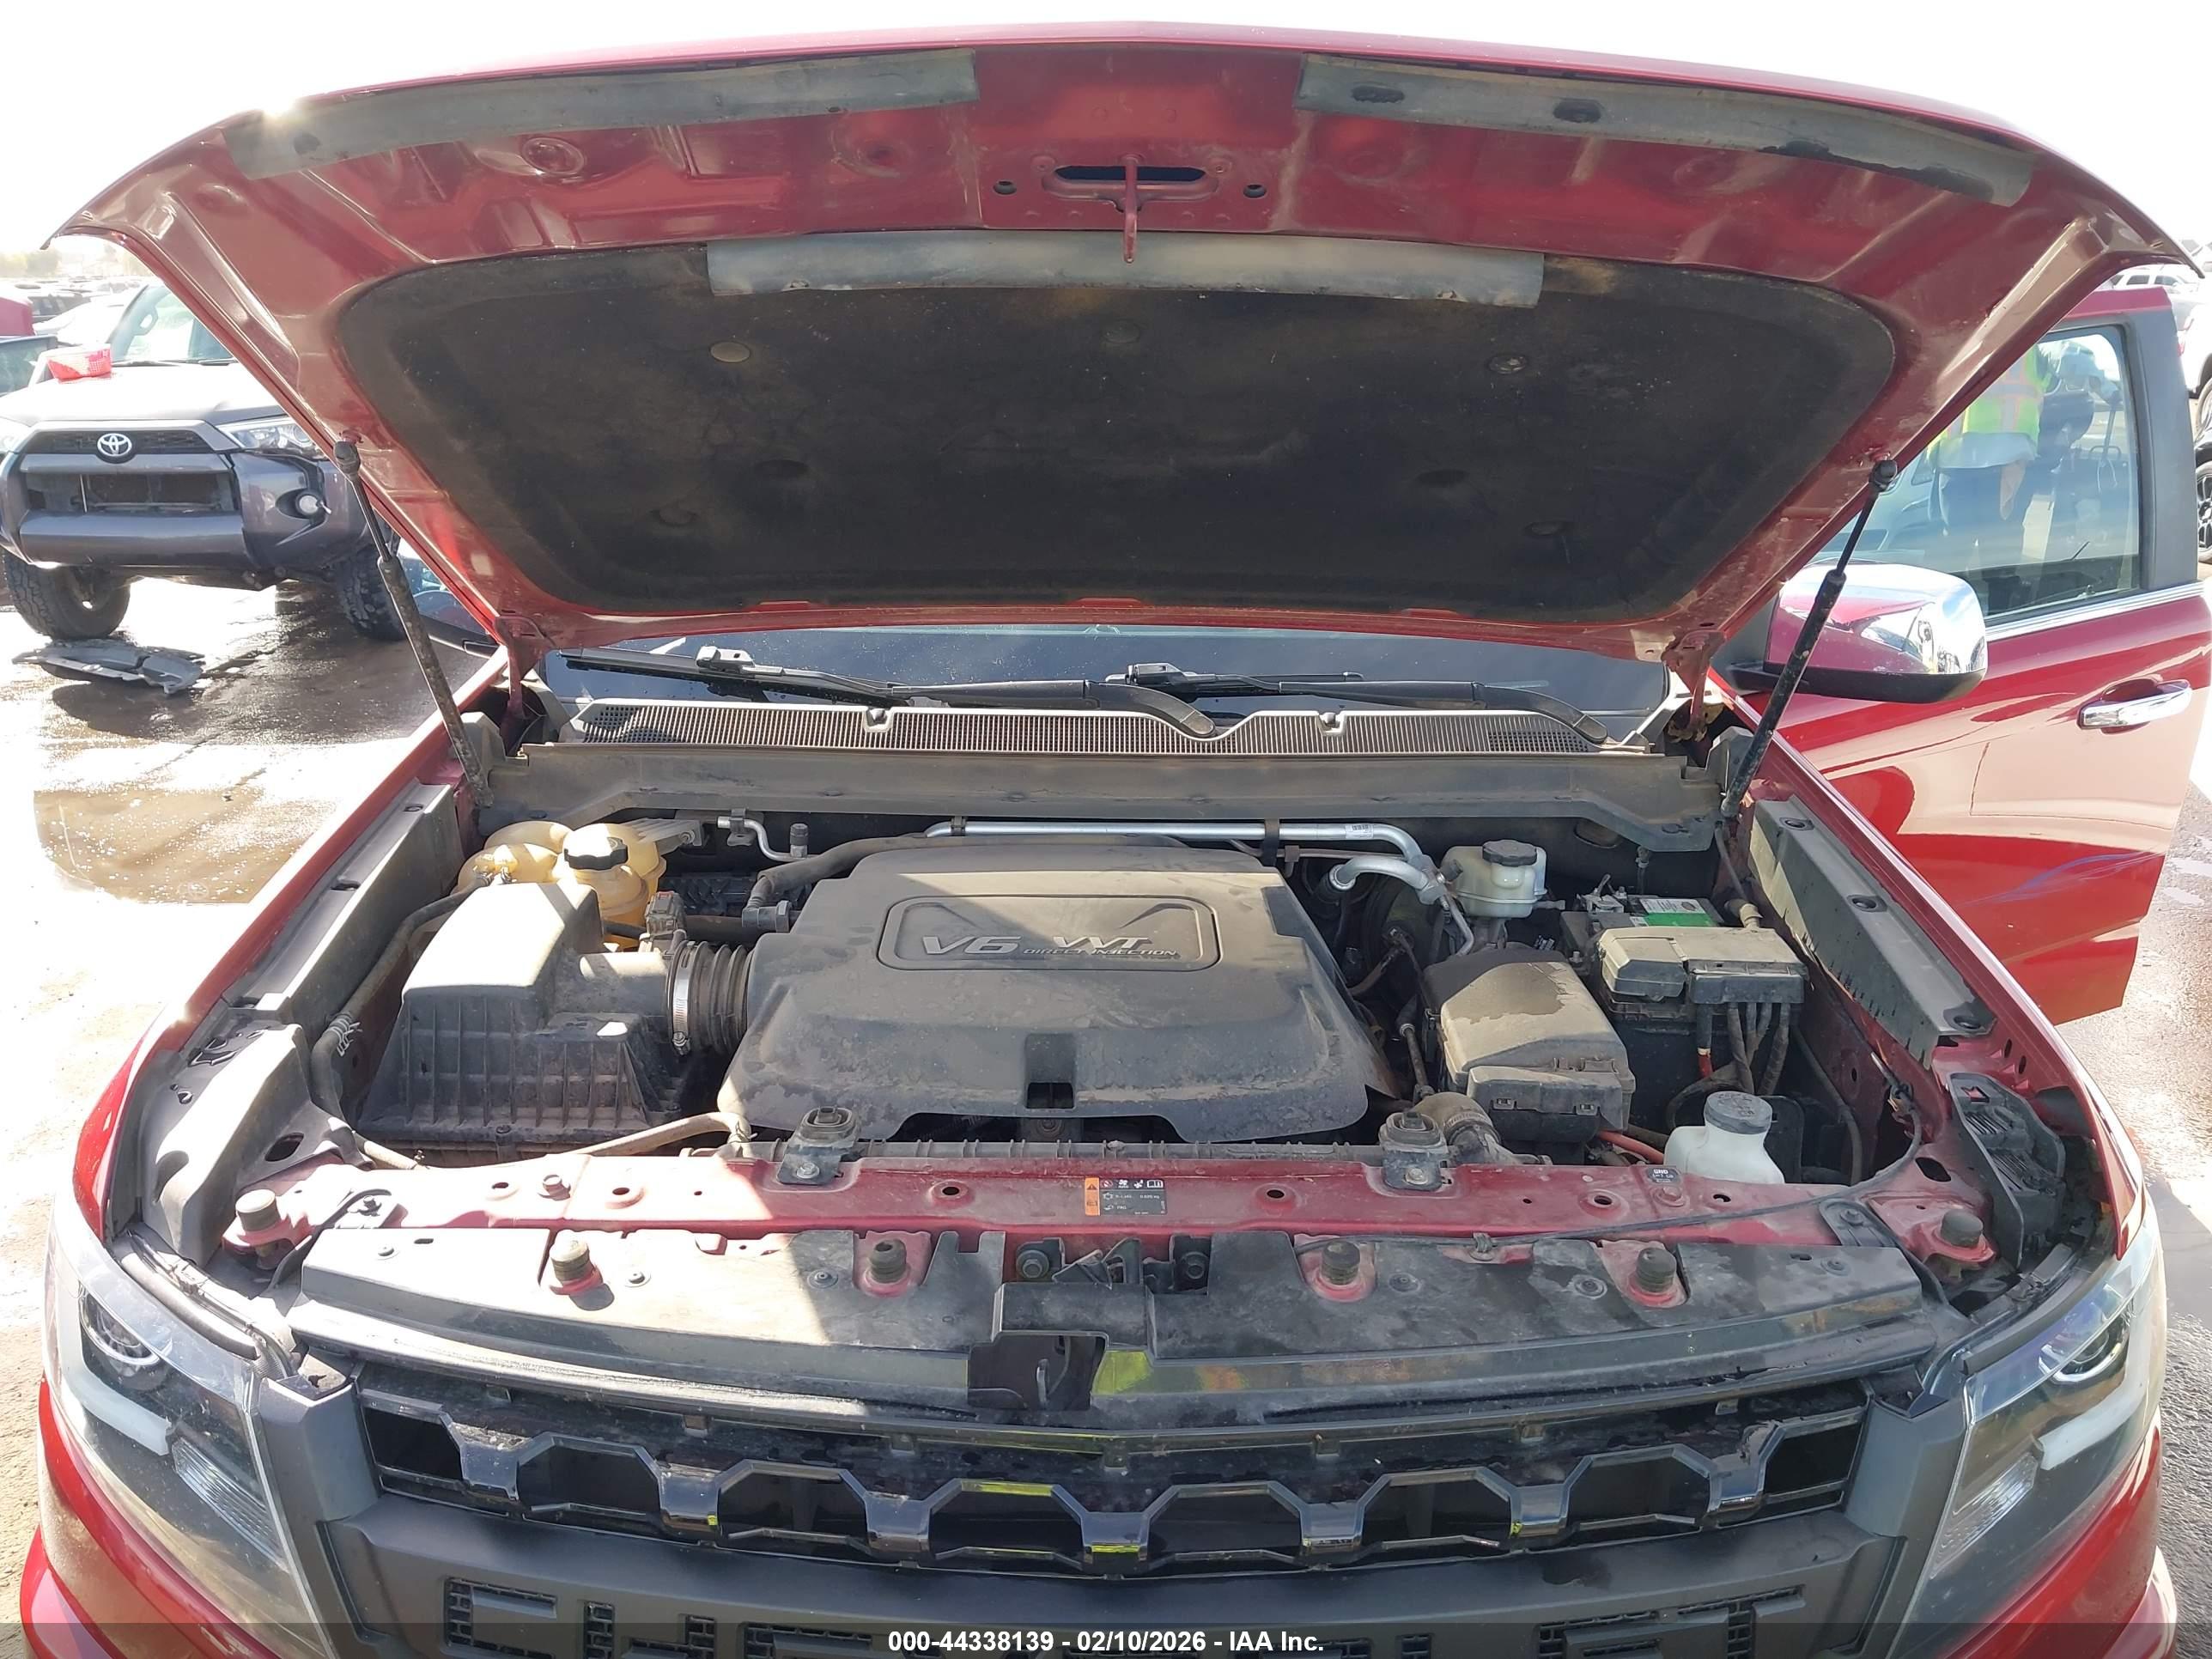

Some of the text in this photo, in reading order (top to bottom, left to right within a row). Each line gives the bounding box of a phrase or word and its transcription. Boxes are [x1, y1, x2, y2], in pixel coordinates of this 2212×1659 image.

[922, 936, 1022, 955] V6
[1053, 936, 1152, 951] VVT
[1091, 948, 1177, 957] INJECTION
